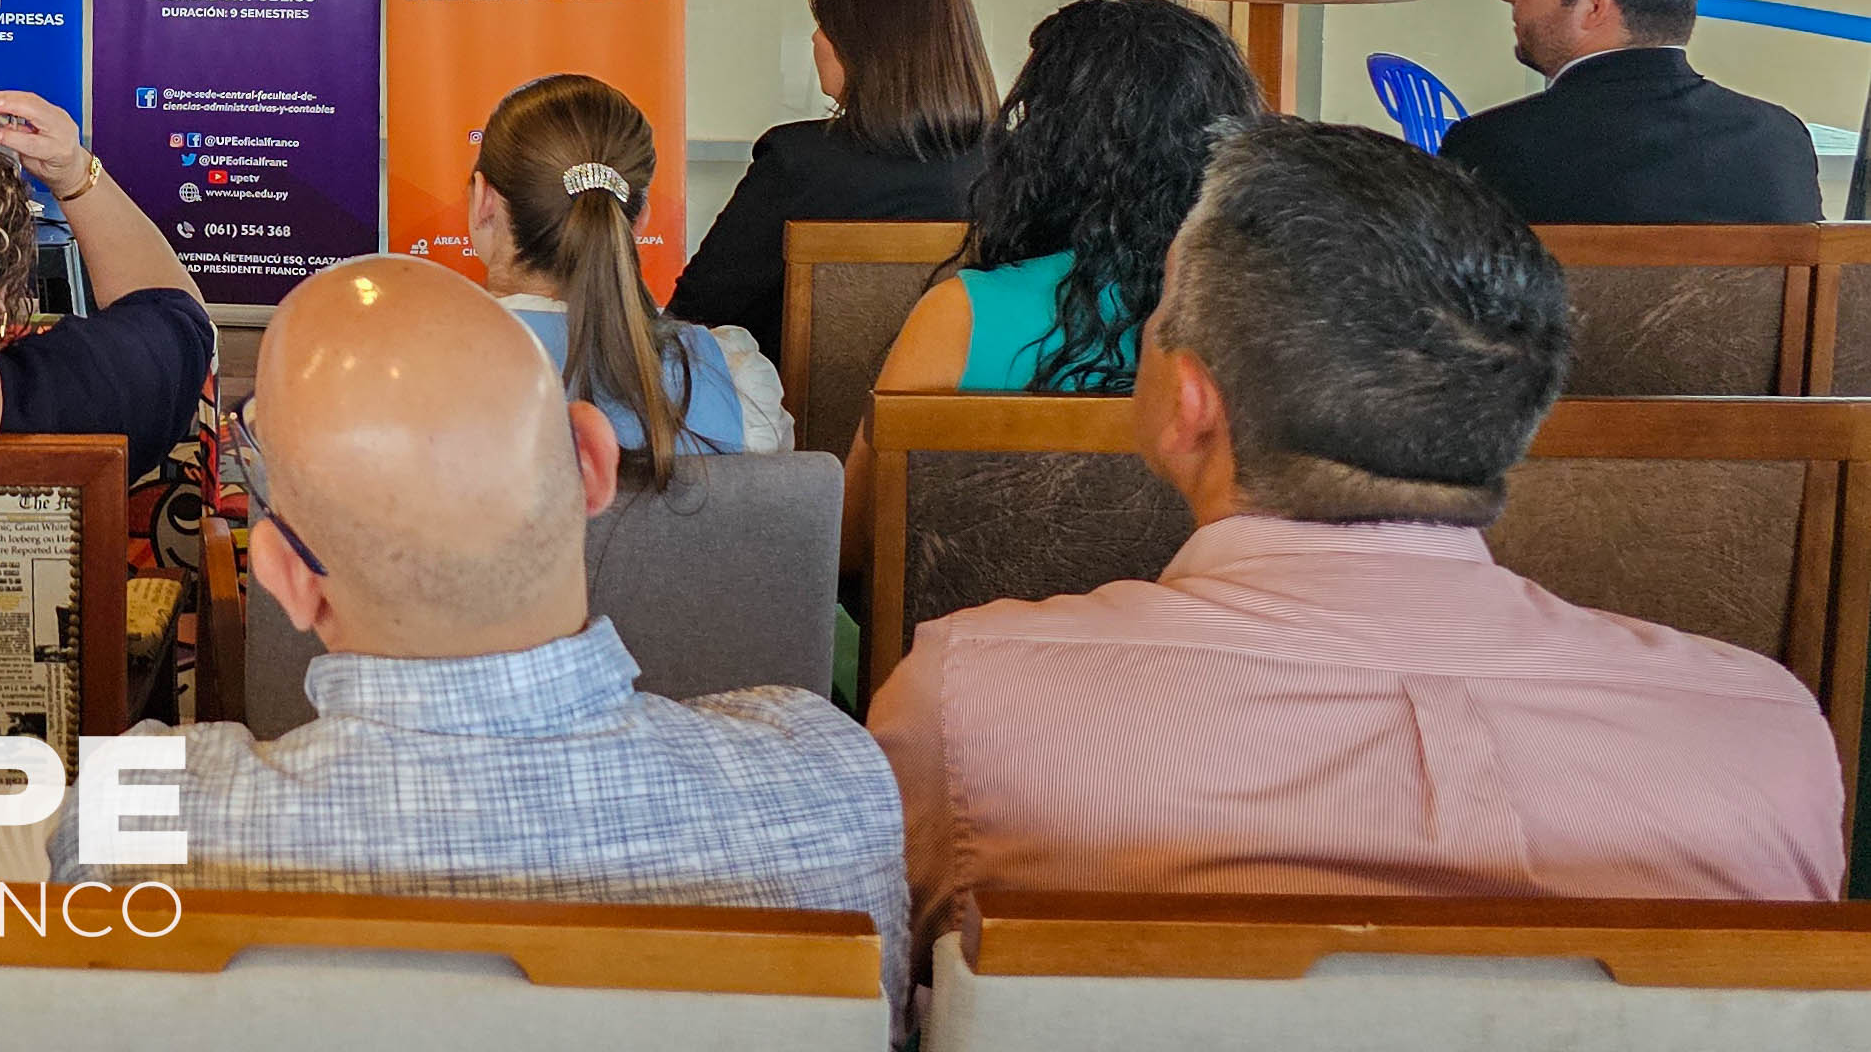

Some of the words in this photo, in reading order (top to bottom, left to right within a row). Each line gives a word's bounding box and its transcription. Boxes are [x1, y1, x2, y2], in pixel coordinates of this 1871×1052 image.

[161, 6, 228, 18] DURACIÓN:
[230, 8, 237, 18] 9
[240, 8, 309, 19] SEMESTRES
[204, 135, 299, 148] @UPEoficialfranco
[199, 154, 288, 167] @UPEoficialfranc
[230, 173, 260, 184] upetv
[206, 188, 288, 200] www.upe.edu.py
[204, 223, 238, 237] (061)
[240, 225, 264, 237] 554
[267, 225, 291, 237] 368
[433, 235, 461, 246] ÁREA
[635, 234, 664, 245] ZAPÁ
[178, 252, 221, 262] AVENIDA
[283, 254, 306, 266] ESQ.
[203, 264, 263, 275] PRESIDENTE
[265, 265, 306, 276] FRANCO
[42, 523, 69, 532] White
[9, 535, 41, 545] Iceberg
[11, 546, 52, 556] Reported
